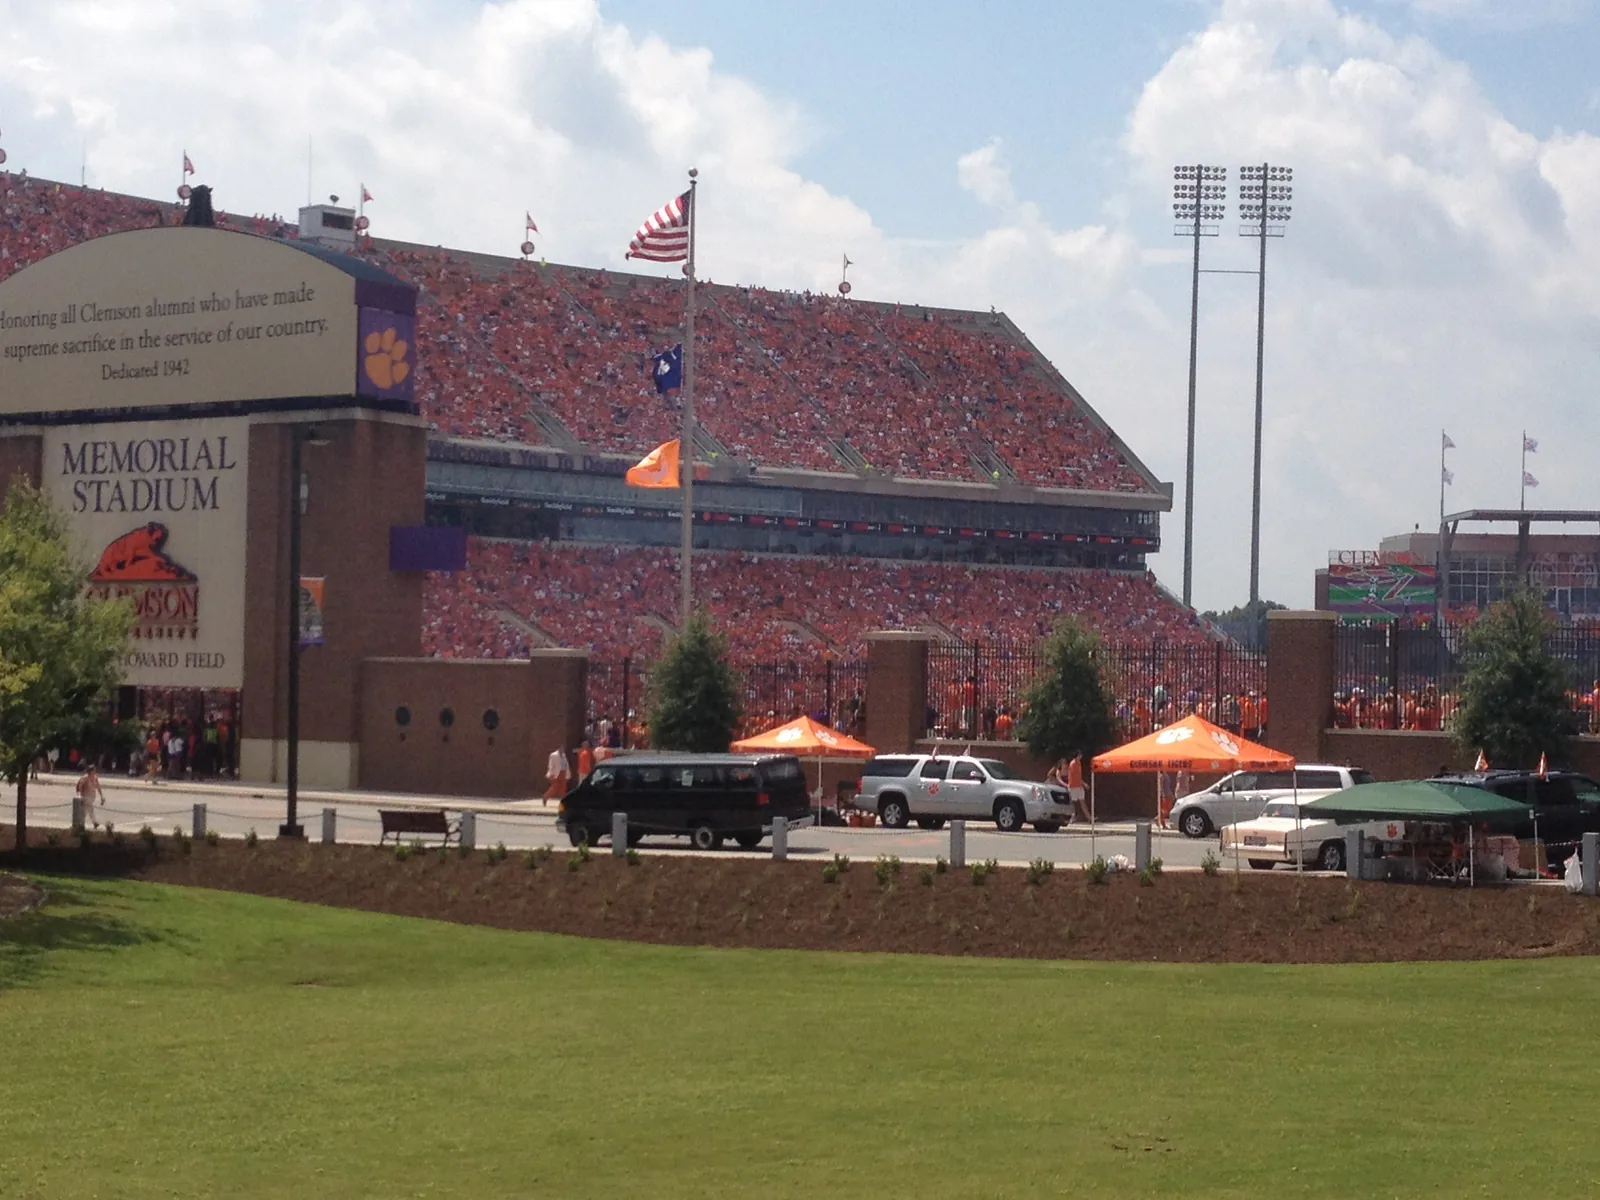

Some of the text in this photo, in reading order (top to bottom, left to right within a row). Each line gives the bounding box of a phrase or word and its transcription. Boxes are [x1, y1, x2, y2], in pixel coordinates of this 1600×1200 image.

[61, 304, 76, 323] all
[80, 302, 141, 323] Clemson
[145, 297, 195, 317] alumni
[200, 291, 231, 312] who
[235, 288, 269, 309] have
[273, 282, 315, 305] made
[3, 318, 329, 362] supreme sacrifice in the service of our country.
[102, 358, 190, 380] Dedicated 1942
[62, 436, 236, 474] MEMORIAL
[73, 476, 220, 512] STADIUM
[184, 652, 226, 669] FIELD
